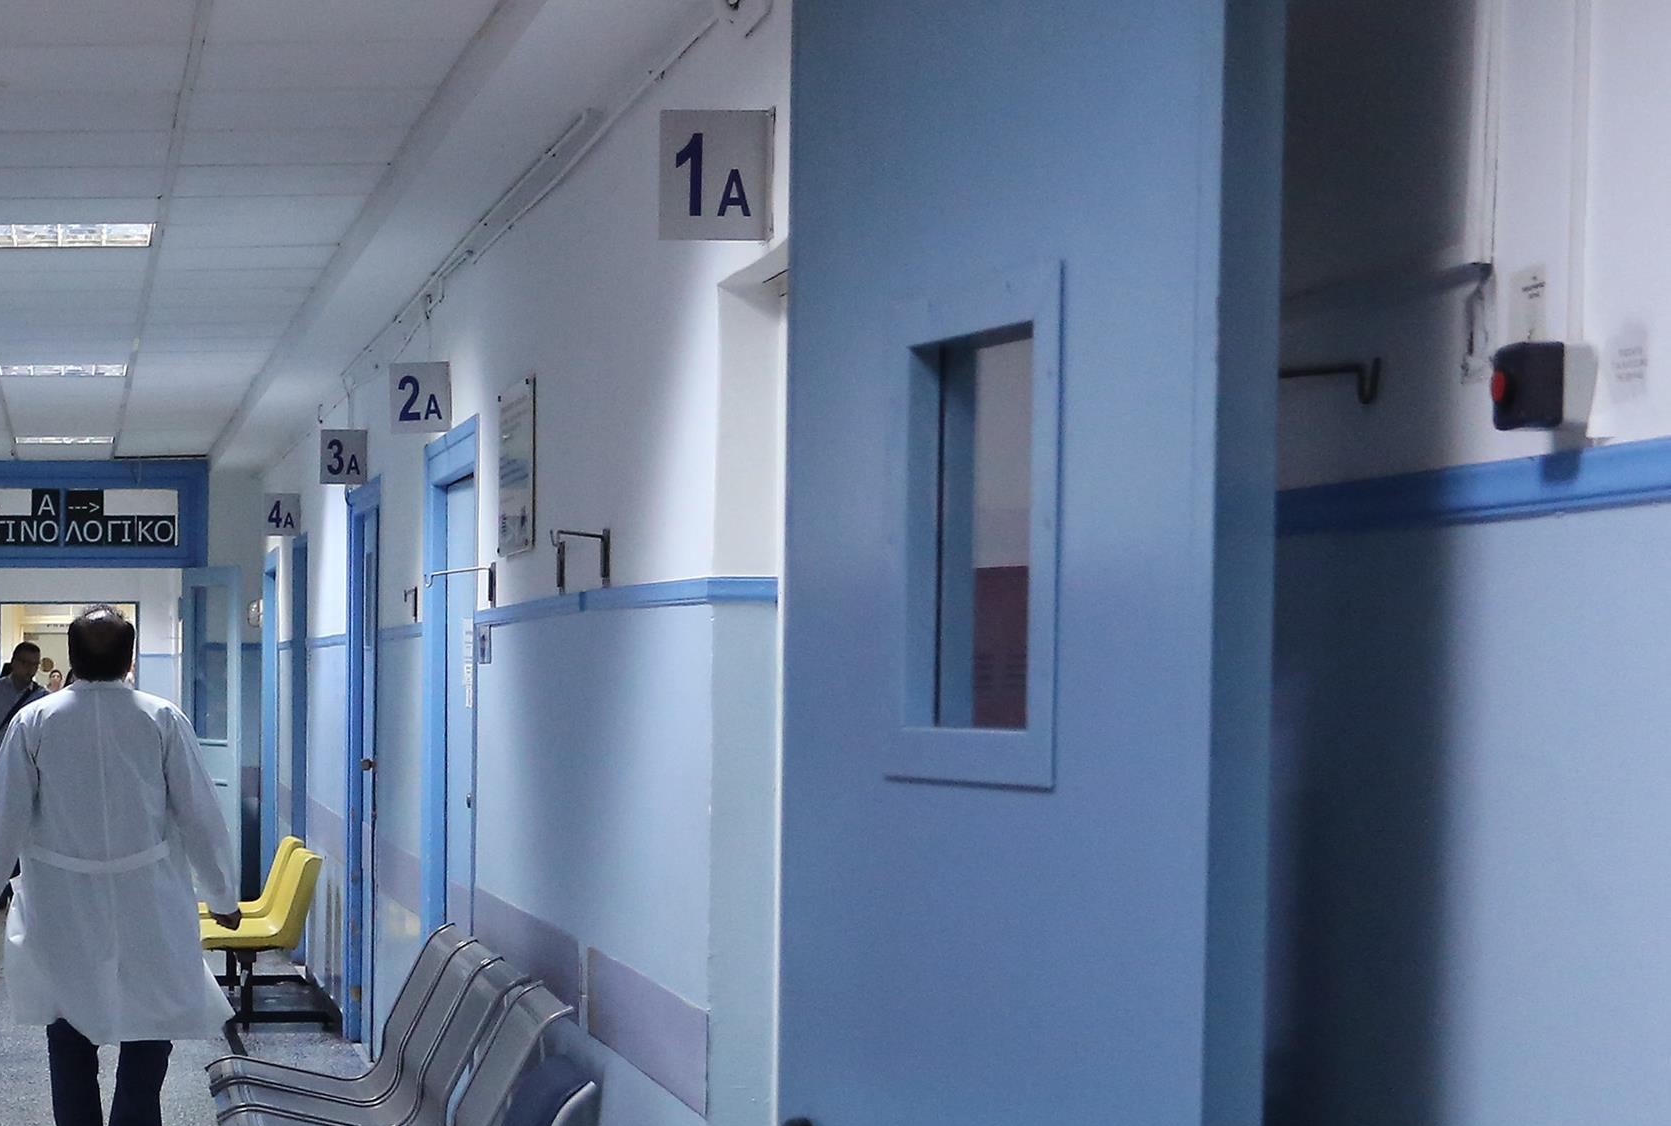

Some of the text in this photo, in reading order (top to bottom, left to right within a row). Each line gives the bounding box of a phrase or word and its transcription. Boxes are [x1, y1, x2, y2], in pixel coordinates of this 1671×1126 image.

[675, 132, 752, 217] 1Α
[397, 375, 443, 421] 2Α
[326, 438, 361, 476] 3Α
[37, 493, 56, 516] Α
[267, 500, 295, 529] 4Α
